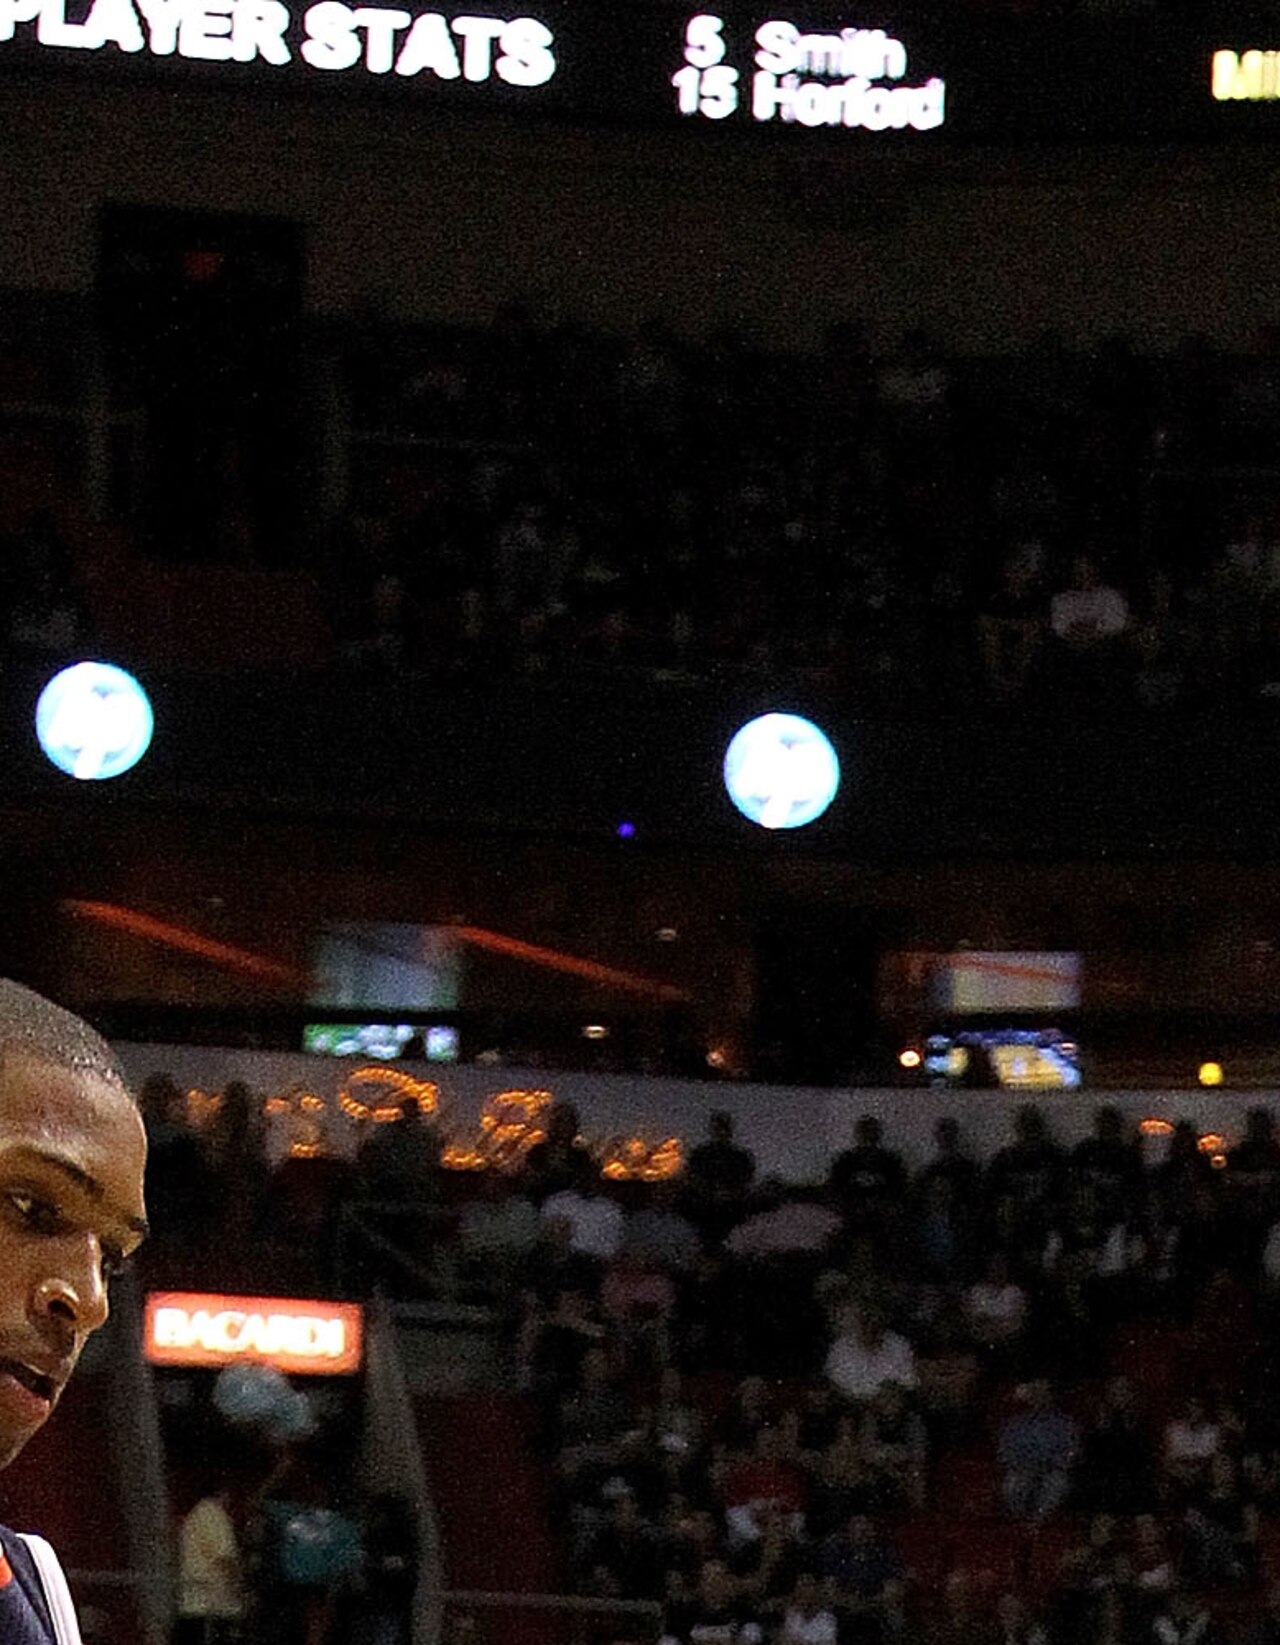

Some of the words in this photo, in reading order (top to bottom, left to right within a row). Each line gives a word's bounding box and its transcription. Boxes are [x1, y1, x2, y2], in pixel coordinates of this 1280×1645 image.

[301, 2, 556, 87] STATS
[683, 14, 726, 68] 5
[753, 20, 907, 80] Smith
[671, 65, 739, 120] 15
[752, 69, 946, 131] Horford
[153, 1307, 345, 1358] BACARDI
